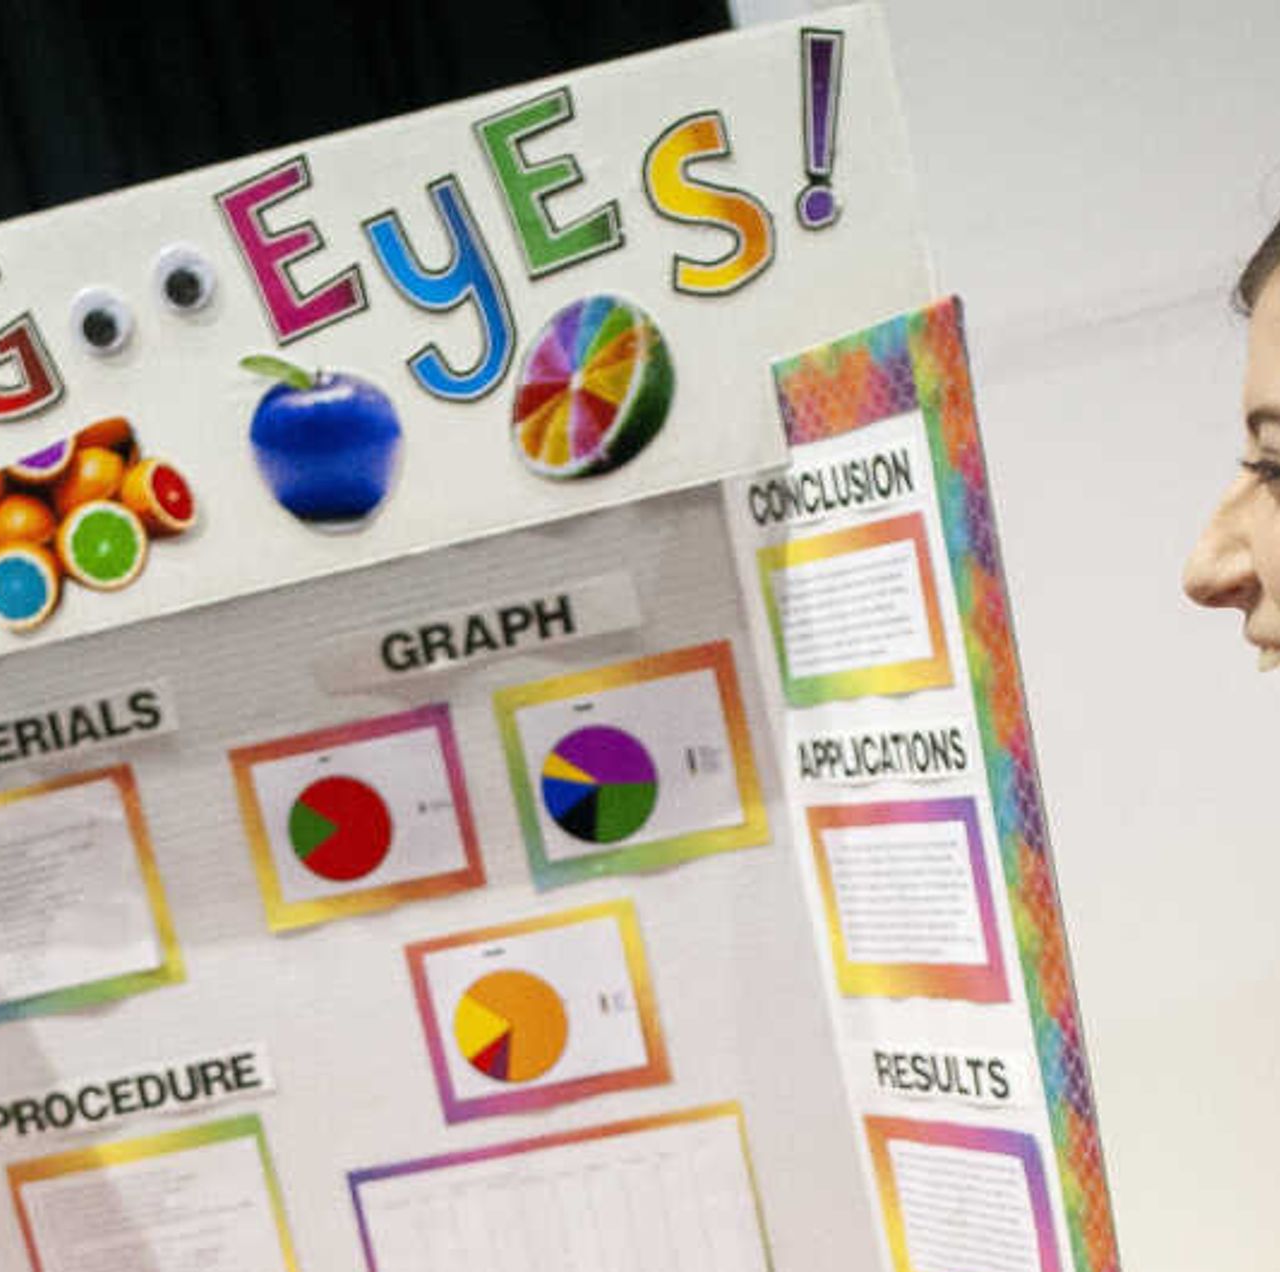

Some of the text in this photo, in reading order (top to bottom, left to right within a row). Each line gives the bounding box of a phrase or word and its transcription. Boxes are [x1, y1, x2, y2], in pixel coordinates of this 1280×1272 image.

[749, 448, 915, 526] CONCLUSION
[380, 594, 576, 673] GRAPH
[798, 728, 967, 780] APPLICATIONS
[874, 1050, 1011, 1099] RESULTS
